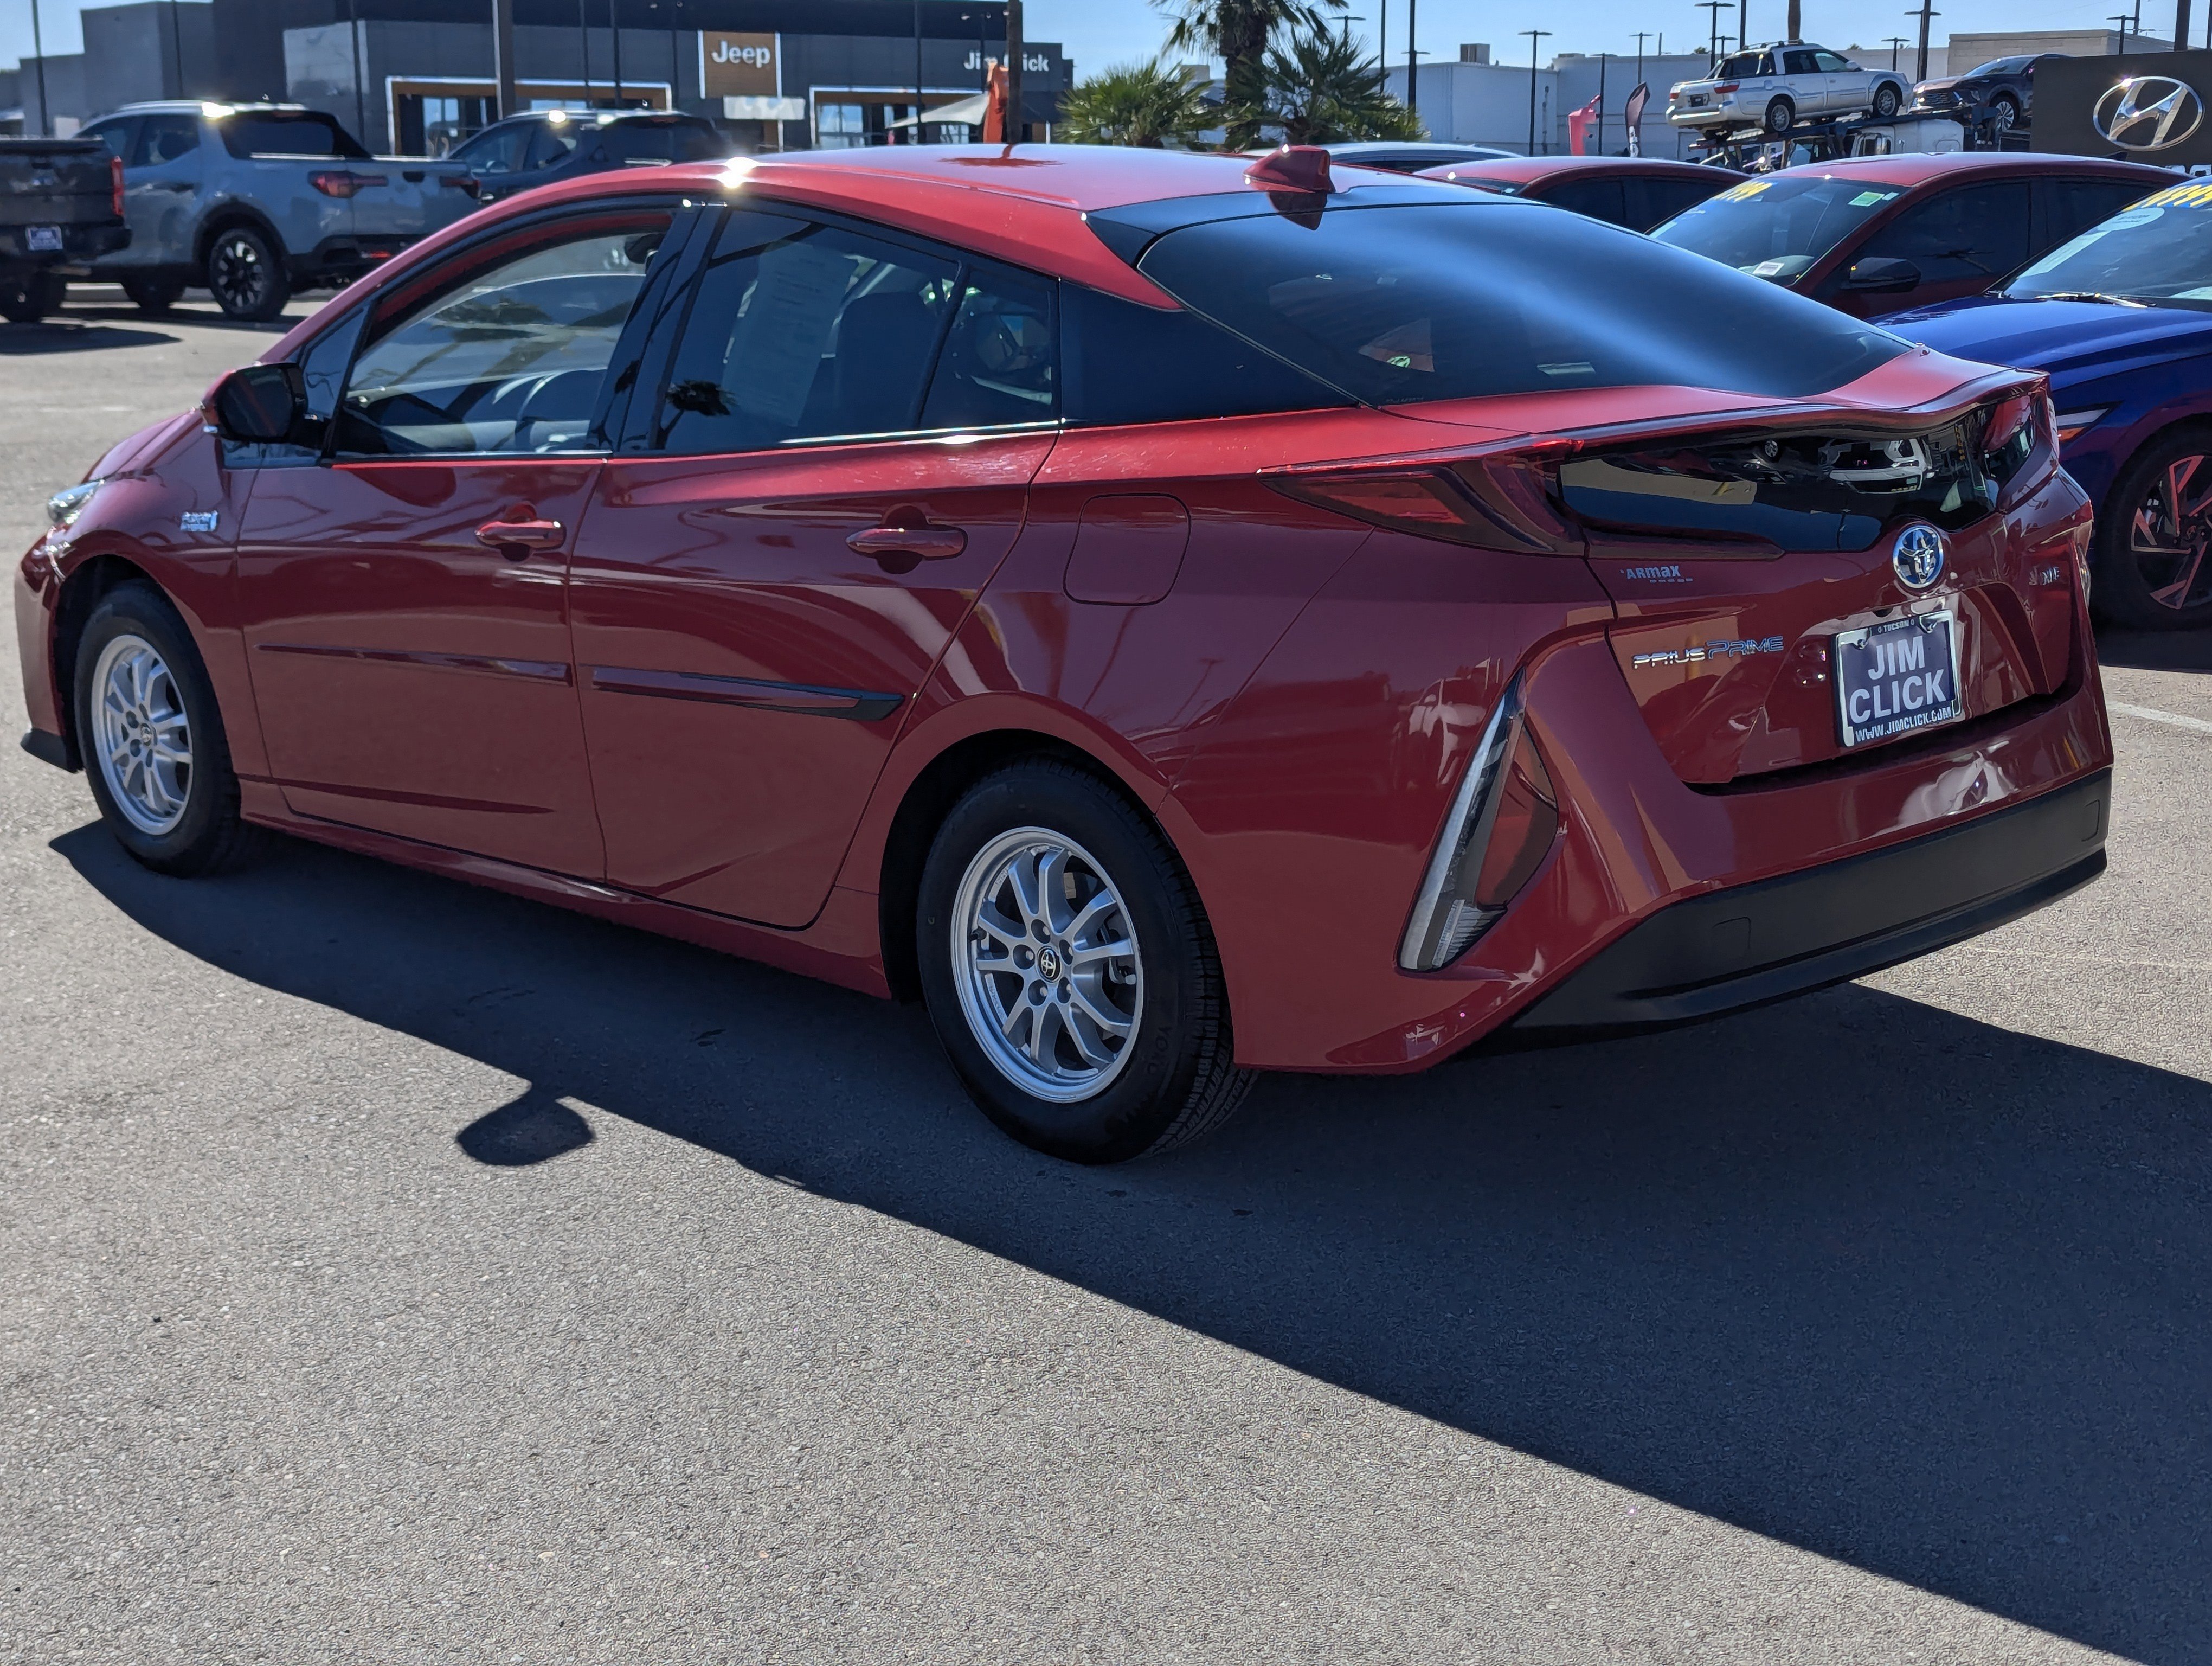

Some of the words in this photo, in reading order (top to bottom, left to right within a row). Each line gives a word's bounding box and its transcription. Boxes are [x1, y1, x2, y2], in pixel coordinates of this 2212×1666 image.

[711, 40, 771, 68] Jeep
[1883, 619, 1909, 632] TUCSON
[1633, 647, 1706, 669] PRIUS
[1706, 636, 1784, 660] PRIME
[1868, 635, 1925, 680] JIM
[1849, 669, 1947, 723] CLICK
